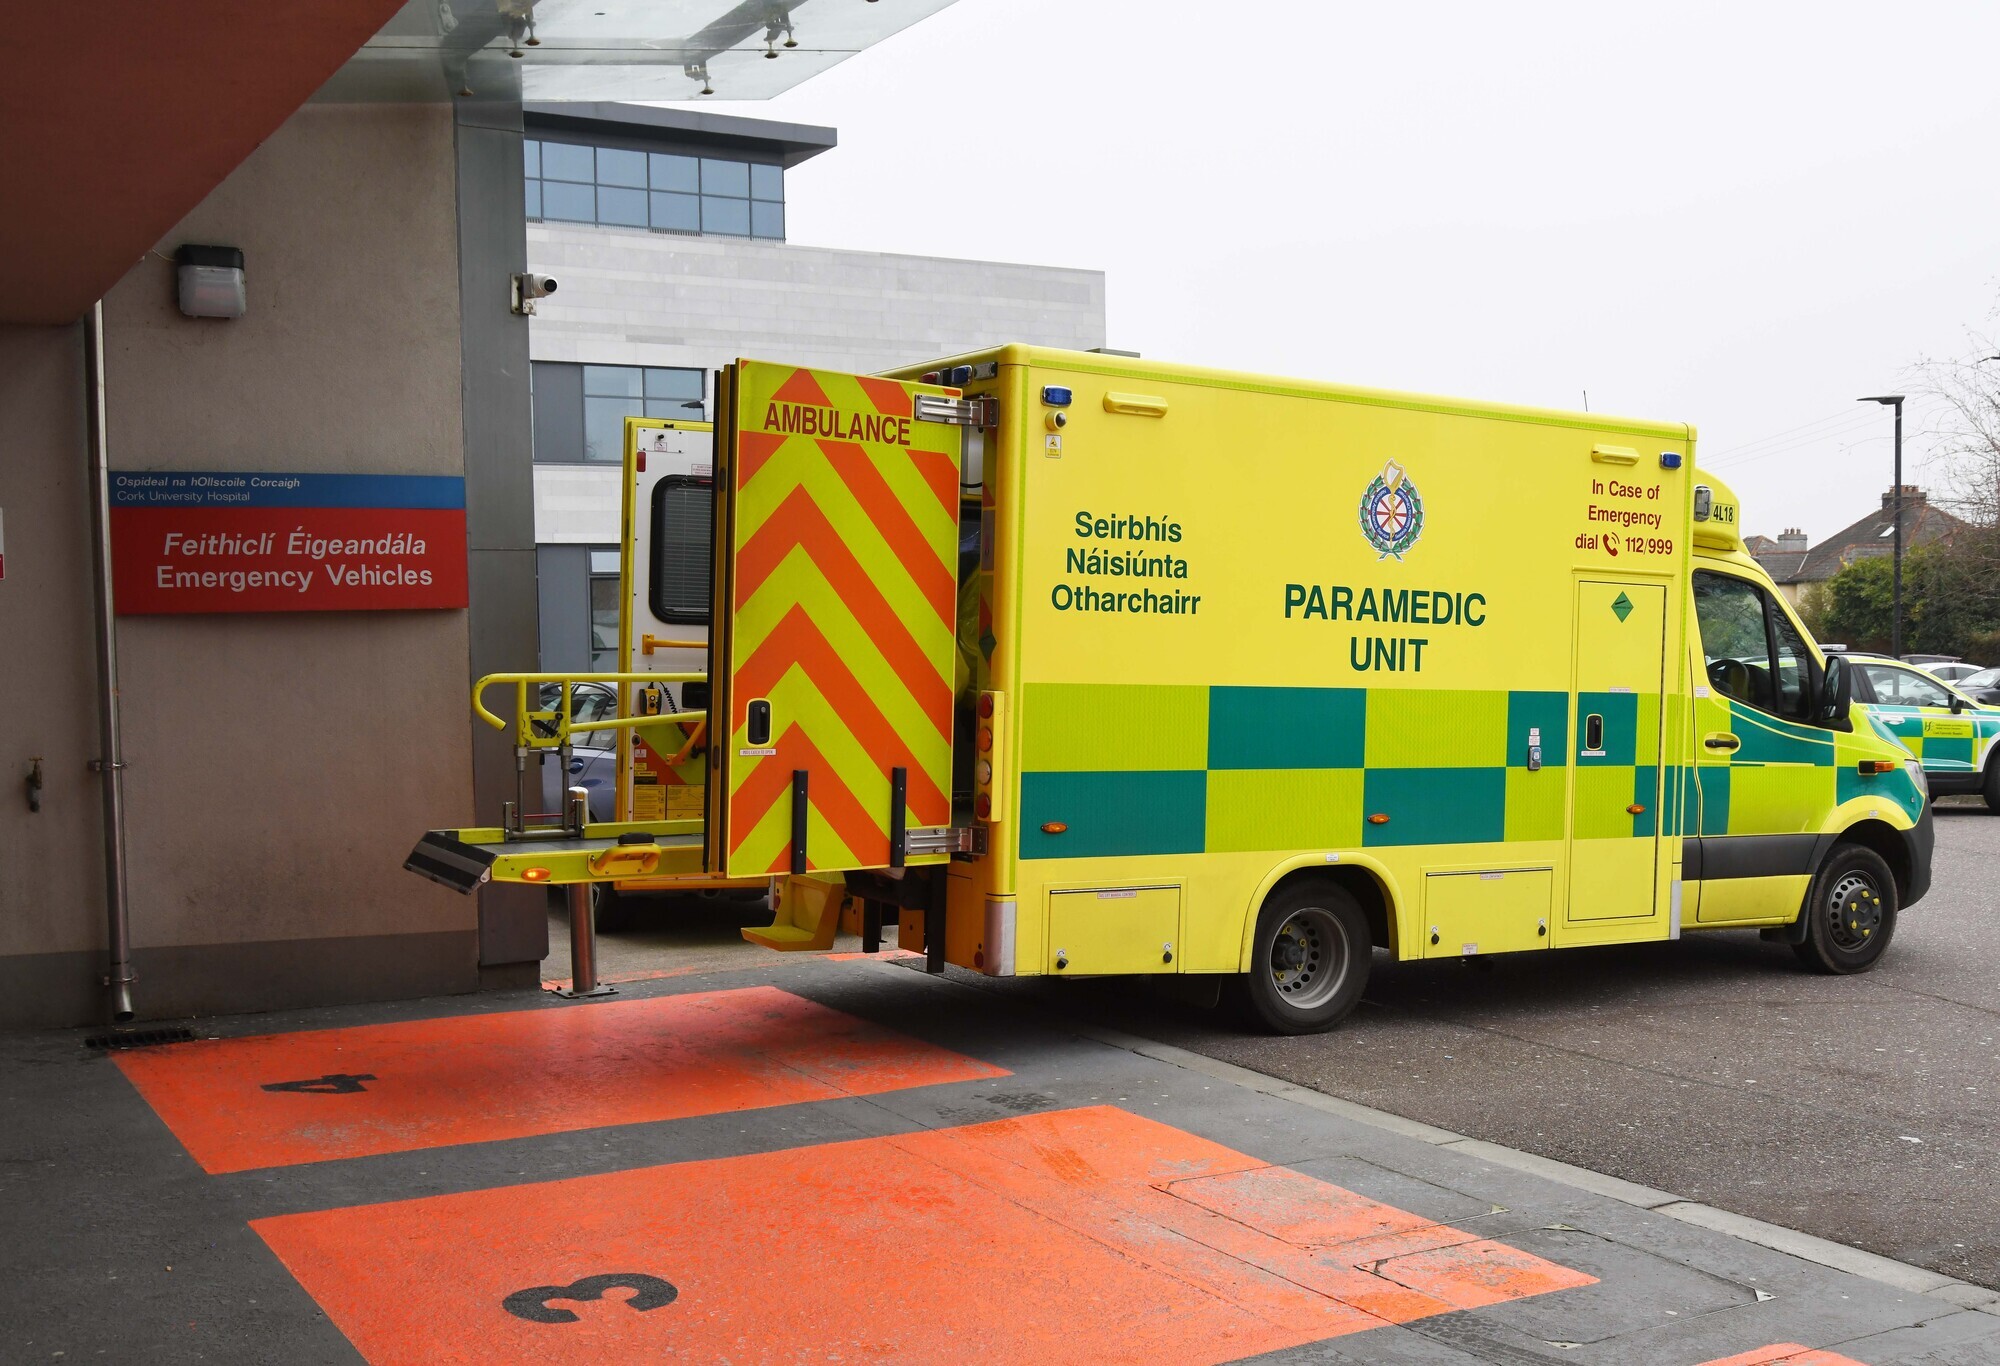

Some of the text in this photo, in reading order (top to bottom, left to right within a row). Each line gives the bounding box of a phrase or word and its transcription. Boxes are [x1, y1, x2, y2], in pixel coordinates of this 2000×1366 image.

[763, 402, 911, 446] AMBULANCE
[116, 476, 300, 490] Ospideal na hOllscoile Corcaigh
[117, 490, 250, 502] Cork University Hospital
[1592, 479, 1660, 500] In Case of
[1074, 511, 1183, 543] Seirbhís
[1588, 504, 1662, 530] Emergency
[1713, 504, 1734, 522] 4L18
[163, 525, 426, 560] Feithiclí Éigeandála
[1575, 533, 1673, 555] dial 112/999
[156, 563, 433, 593] Emergency Vehicles
[1066, 547, 1189, 579] Náisiúnta
[1051, 584, 1201, 615] Otharchairr
[1284, 583, 1487, 628] PARAMEDIC
[1349, 636, 1429, 673] UNIT
[260, 1073, 378, 1095] 4
[502, 1272, 679, 1324] 3
